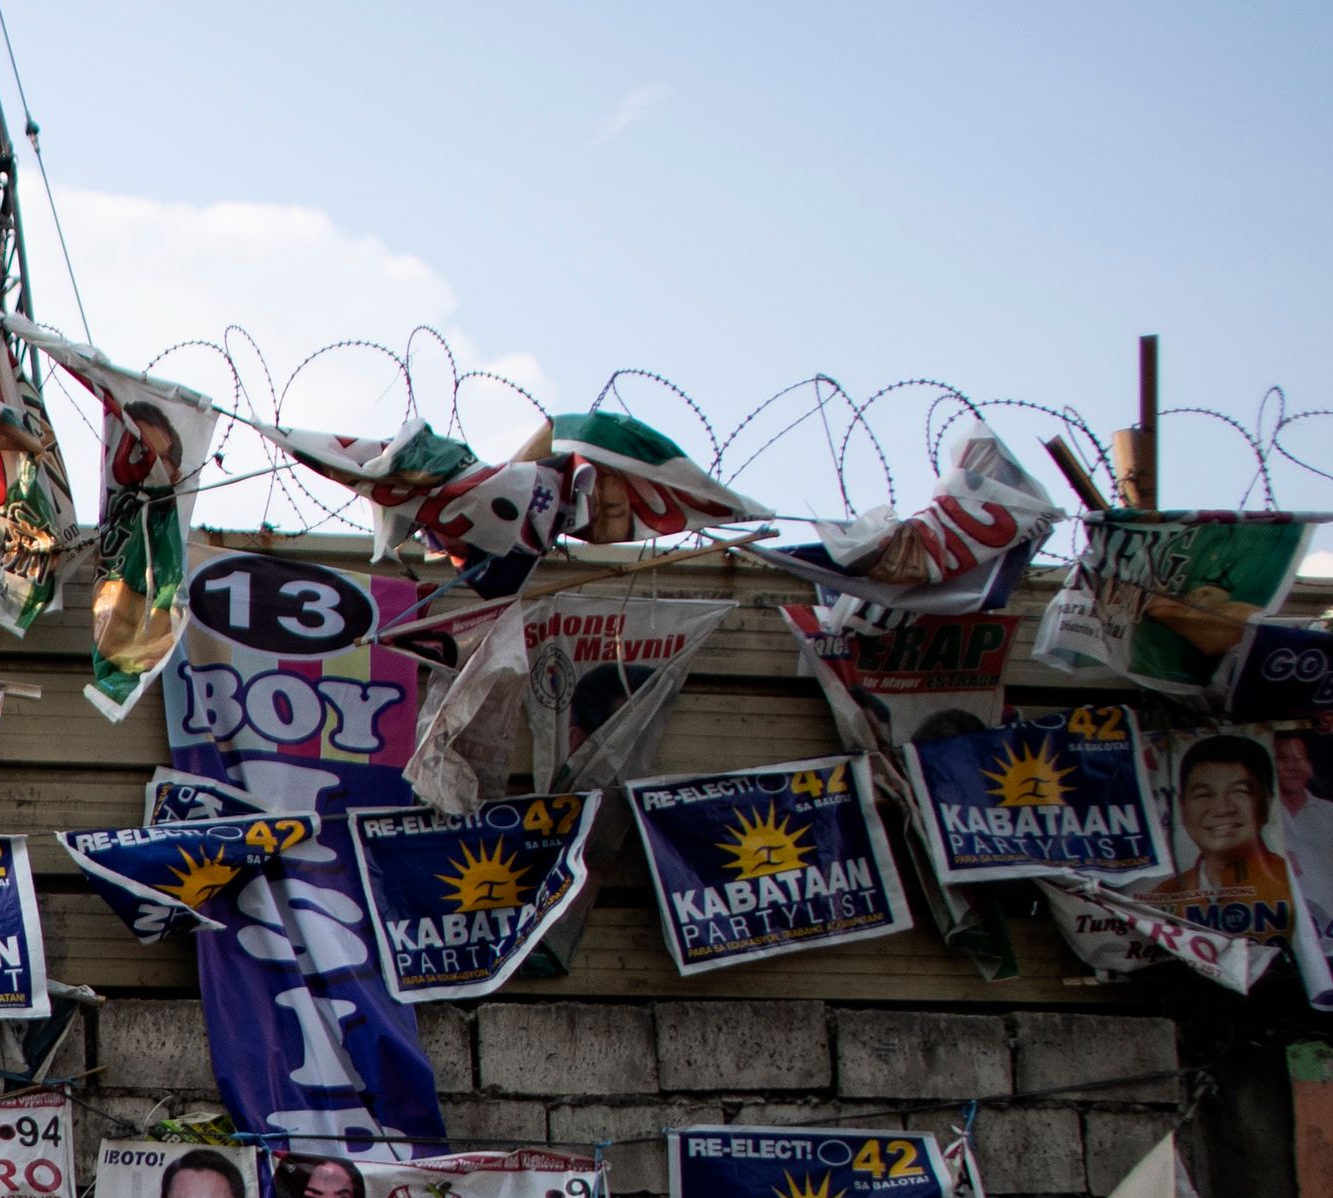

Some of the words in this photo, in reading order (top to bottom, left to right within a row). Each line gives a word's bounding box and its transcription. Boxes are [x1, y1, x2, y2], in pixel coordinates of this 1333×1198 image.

[205, 571, 345, 639] 13
[178, 660, 405, 752] BOY
[939, 803, 1139, 838] KABATAAN
[672, 857, 874, 924] KABATAAN
[683, 889, 878, 948] PARTYLIST
[16, 1116, 61, 1147] 94
[104, 1149, 165, 1166] IBOTO!
[688, 1138, 813, 1160] RE-ELECT!
[852, 1139, 925, 1178] 42
